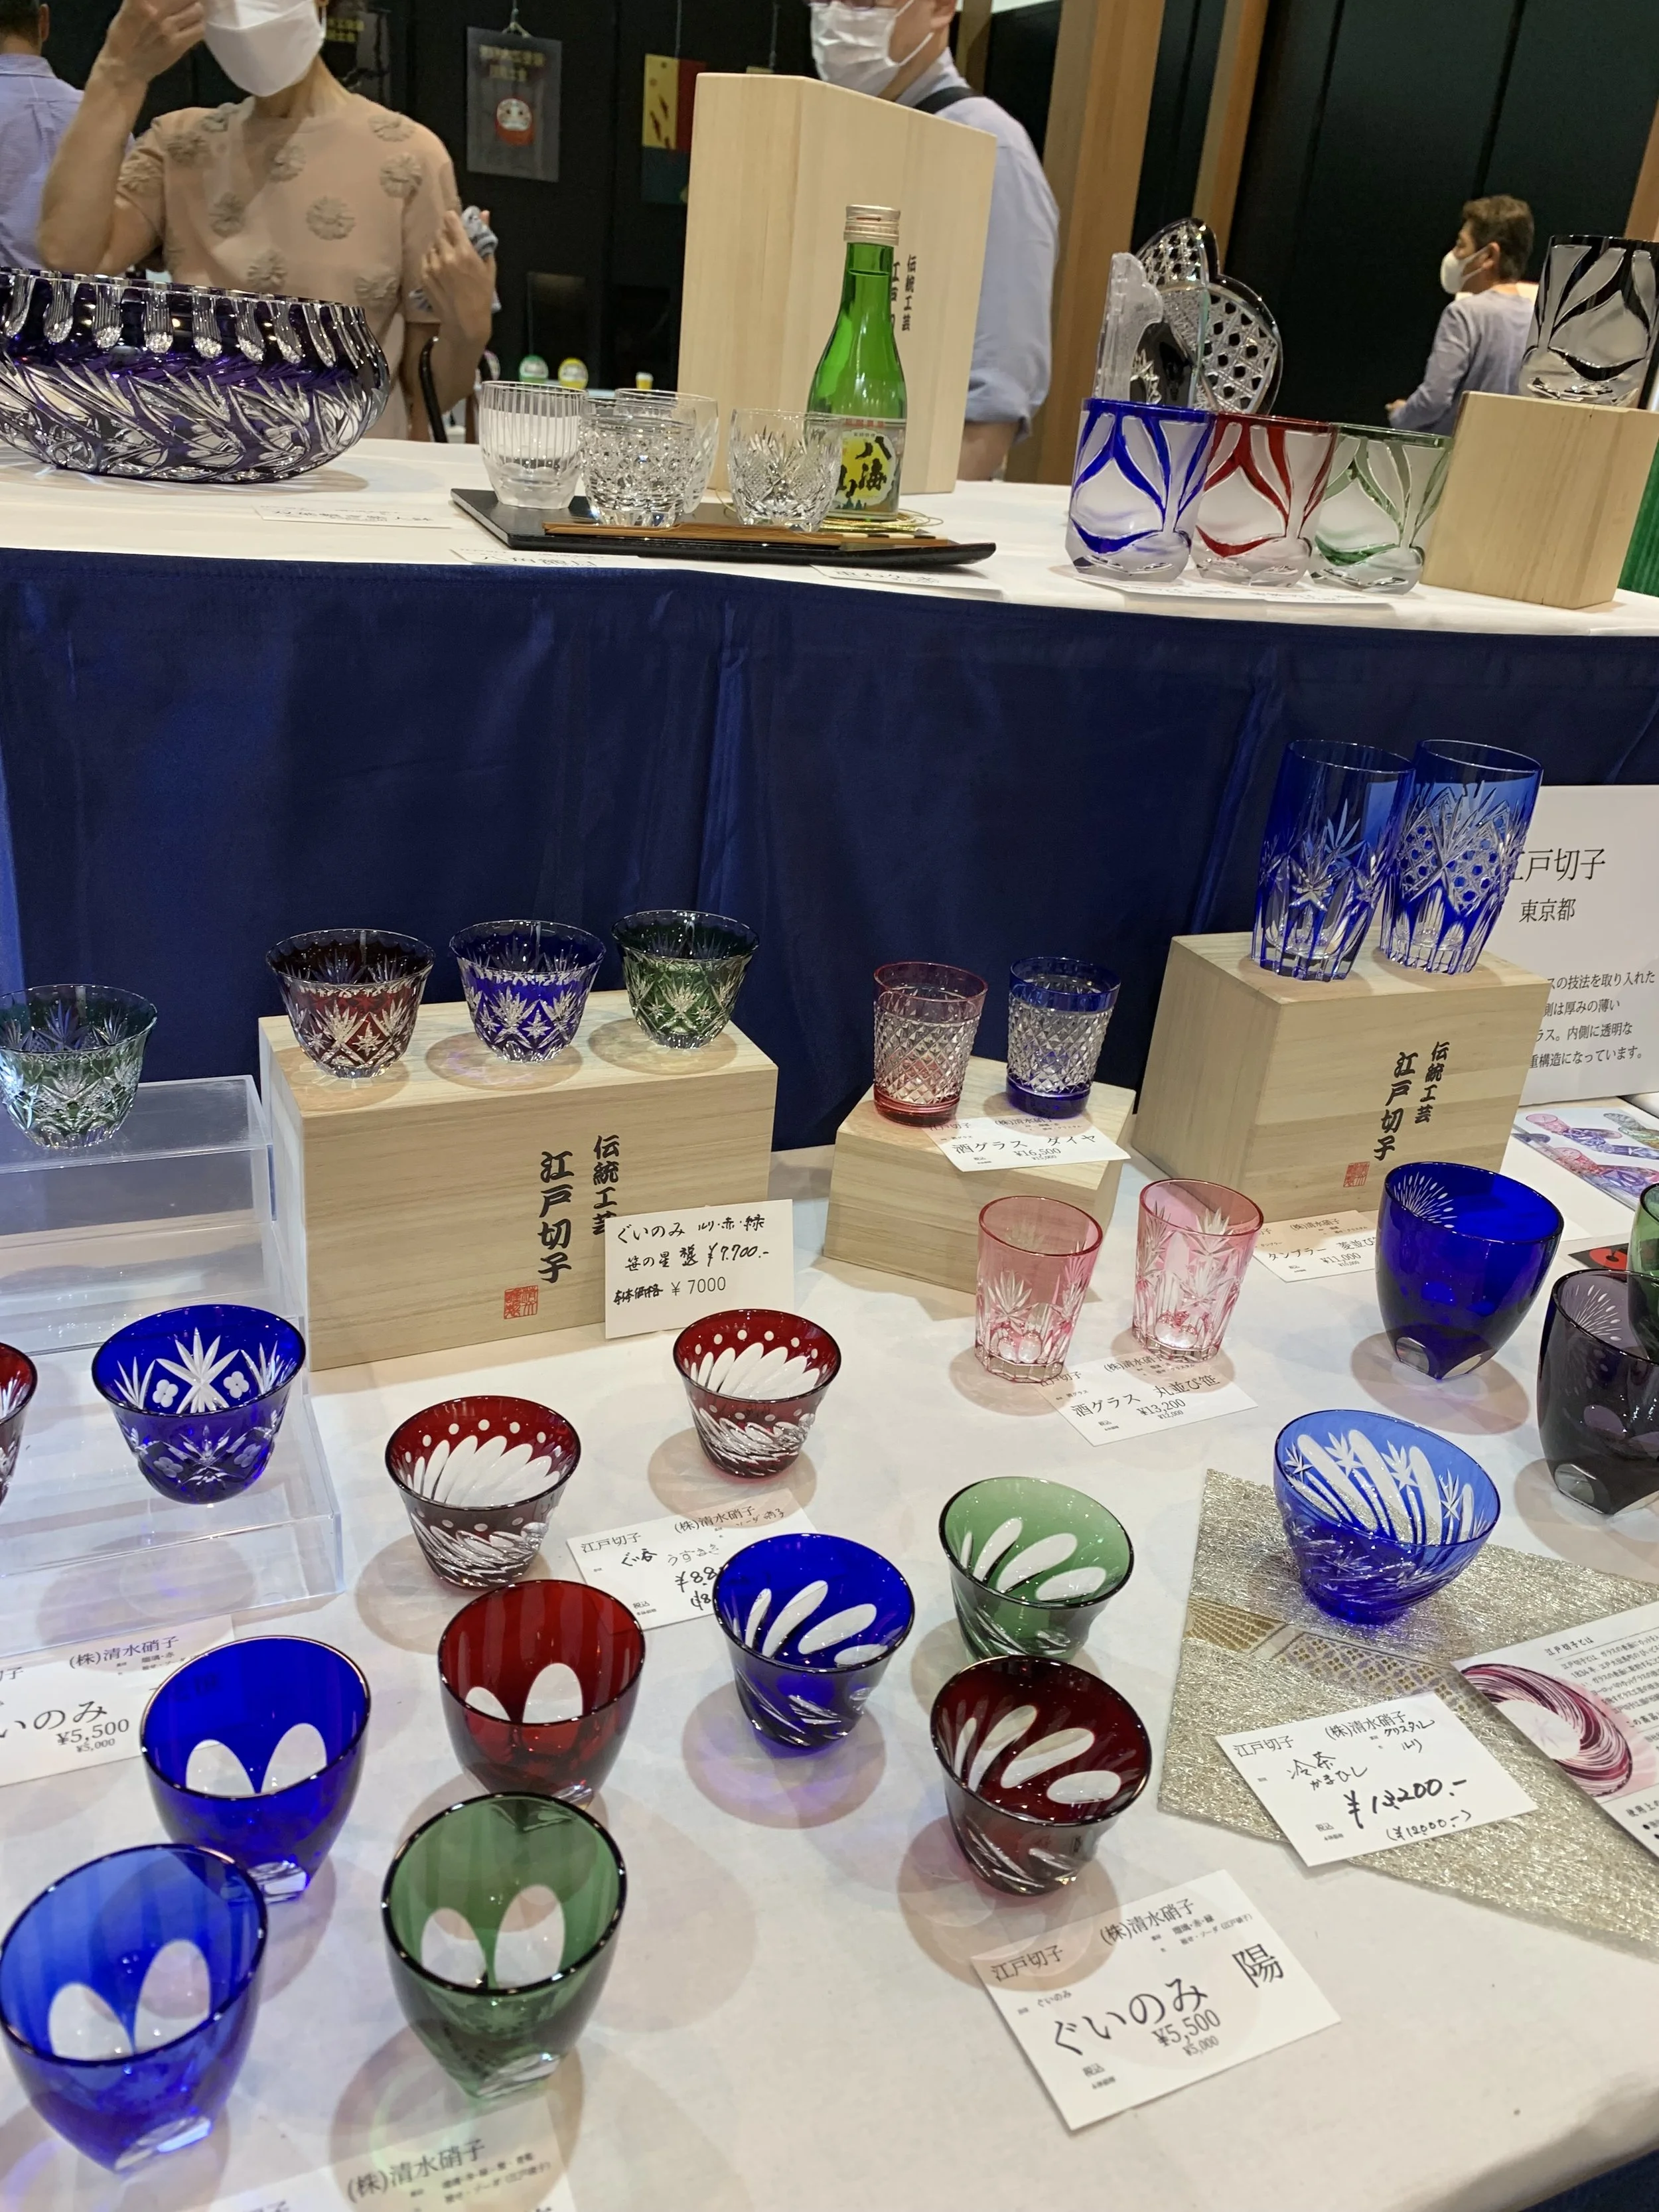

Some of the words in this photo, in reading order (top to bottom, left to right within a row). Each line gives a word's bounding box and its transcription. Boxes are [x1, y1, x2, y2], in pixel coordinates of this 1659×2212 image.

[1518, 897, 1577, 924] 東京都
[1414, 1041, 1450, 1124] 伝統工芸
[1373, 1051, 1419, 1161] 江戸切子
[952, 1140, 1029, 1155] 酒グラス
[1047, 1134, 1096, 1147] ダイヤ
[1013, 1147, 1062, 1158] ¥16,500
[537, 1150, 575, 1284] 江戸切子
[617, 1222, 685, 1244] ぐいのみ
[624, 1251, 670, 1272] 笹の星
[1268, 1247, 1327, 1262] タンブラー
[1319, 1252, 1362, 1264] ¥11,000
[1070, 1393, 1141, 1418] 酒グラス
[1153, 1374, 1221, 1399] 丸並び笹
[1136, 1398, 1187, 1416] ¥13,200
[581, 1532, 642, 1554] 江戸切子
[674, 1505, 756, 1535] (株)清水硝子
[68, 1635, 180, 1670] (株)清水硝子
[1544, 1636, 1595, 1657] 江戸切子とは
[55, 1718, 130, 1746] ¥5,500
[76, 1737, 116, 1753] ¥5,000
[1232, 1735, 1294, 1758] 江戸切子
[1325, 1710, 1407, 1741] (株)清水硝子
[1287, 1751, 1336, 1779] 冷茶
[990, 1944, 1063, 1982] 江戸切子
[1100, 1897, 1194, 1947] (株)清水硝子
[1037, 1990, 1072, 2008] ぐいのみ
[1054, 1978, 1208, 2057] ぐいのみ
[1231, 1943, 1284, 1988] 陽
[1151, 2008, 1221, 2048] ¥5,500
[1182, 2035, 1220, 2057] ¥5,000
[347, 2138, 486, 2203] (株)清水硝子
